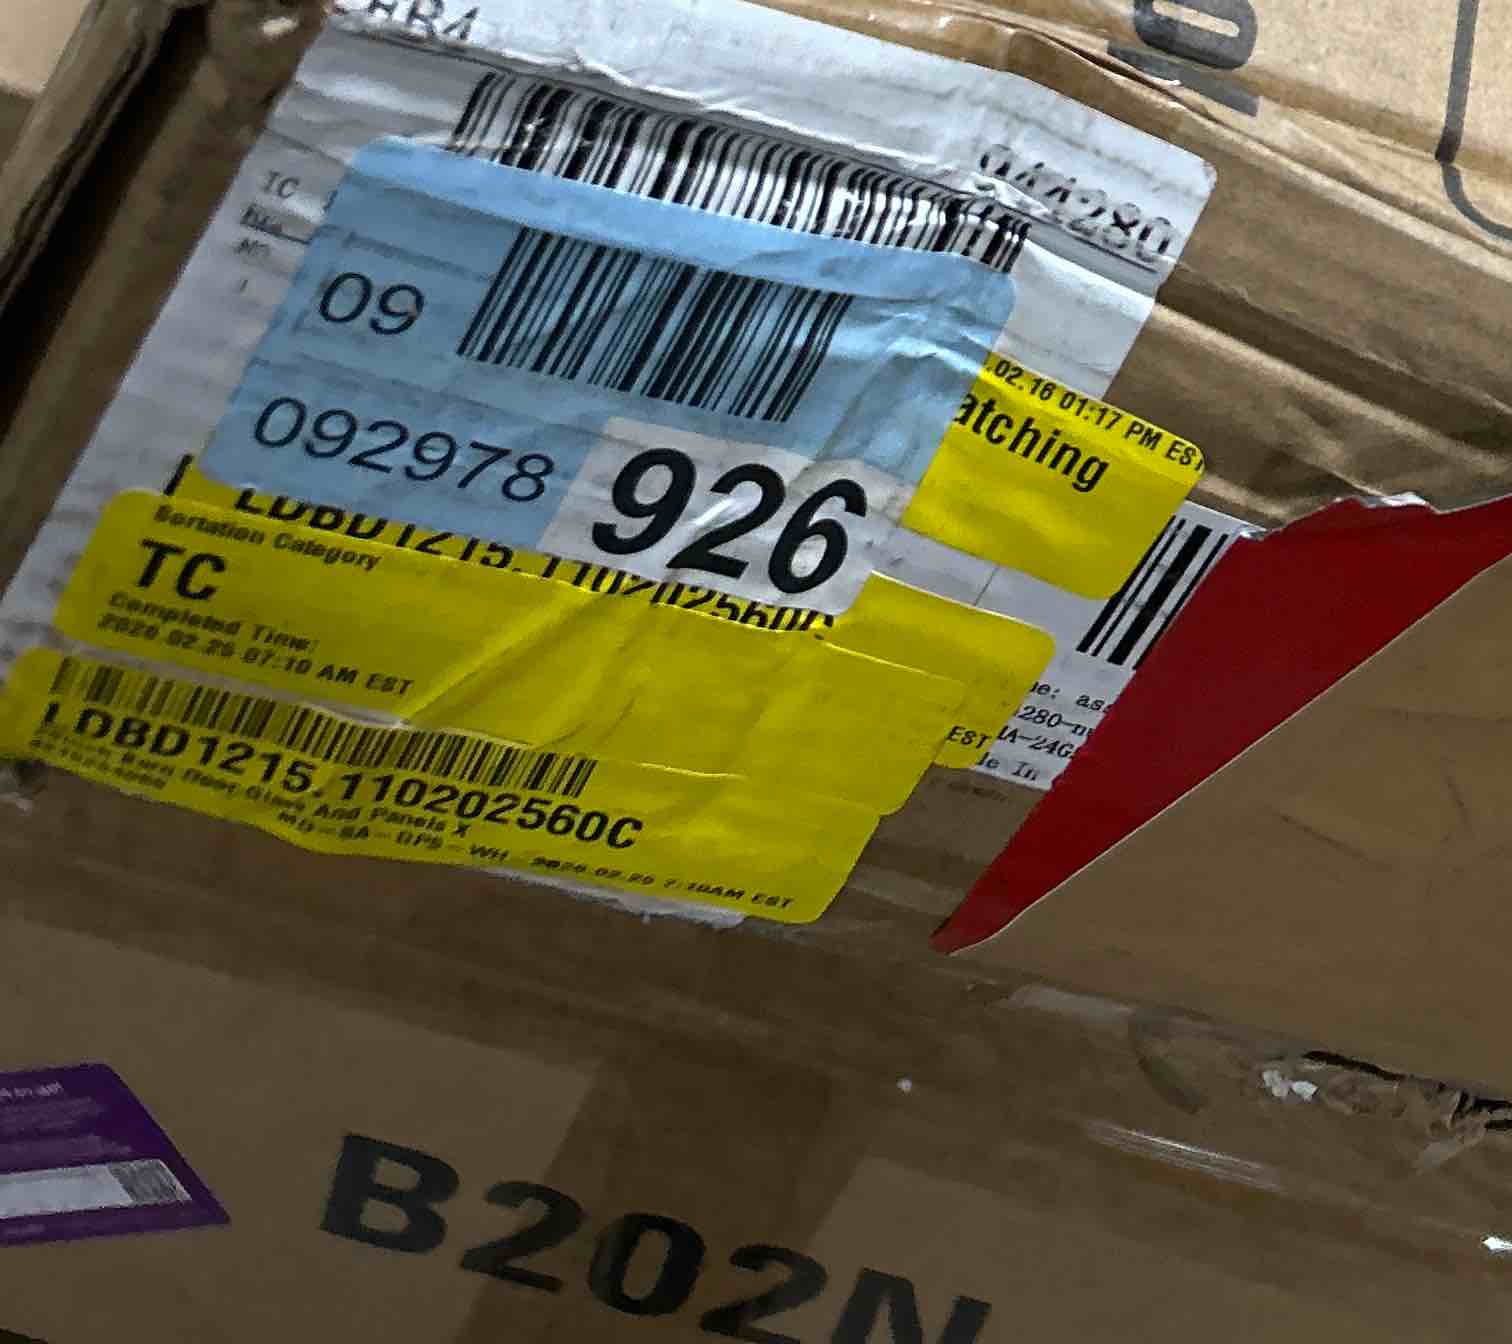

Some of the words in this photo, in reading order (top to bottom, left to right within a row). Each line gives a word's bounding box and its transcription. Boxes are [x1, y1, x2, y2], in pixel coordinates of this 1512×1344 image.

[317, 270, 426, 336] 09
[252, 396, 556, 504] 092978
[1058, 391, 1124, 431] 01:17
[1123, 420, 1165, 451] PM
[272, 530, 384, 572] Category
[590, 447, 868, 596] 926
[136, 537, 227, 604] TC
[108, 591, 242, 636] Completed
[315, 663, 360, 685] AM
[365, 672, 416, 697] EST
[945, 725, 994, 750] EST
[318, 1133, 992, 1344] B202N
